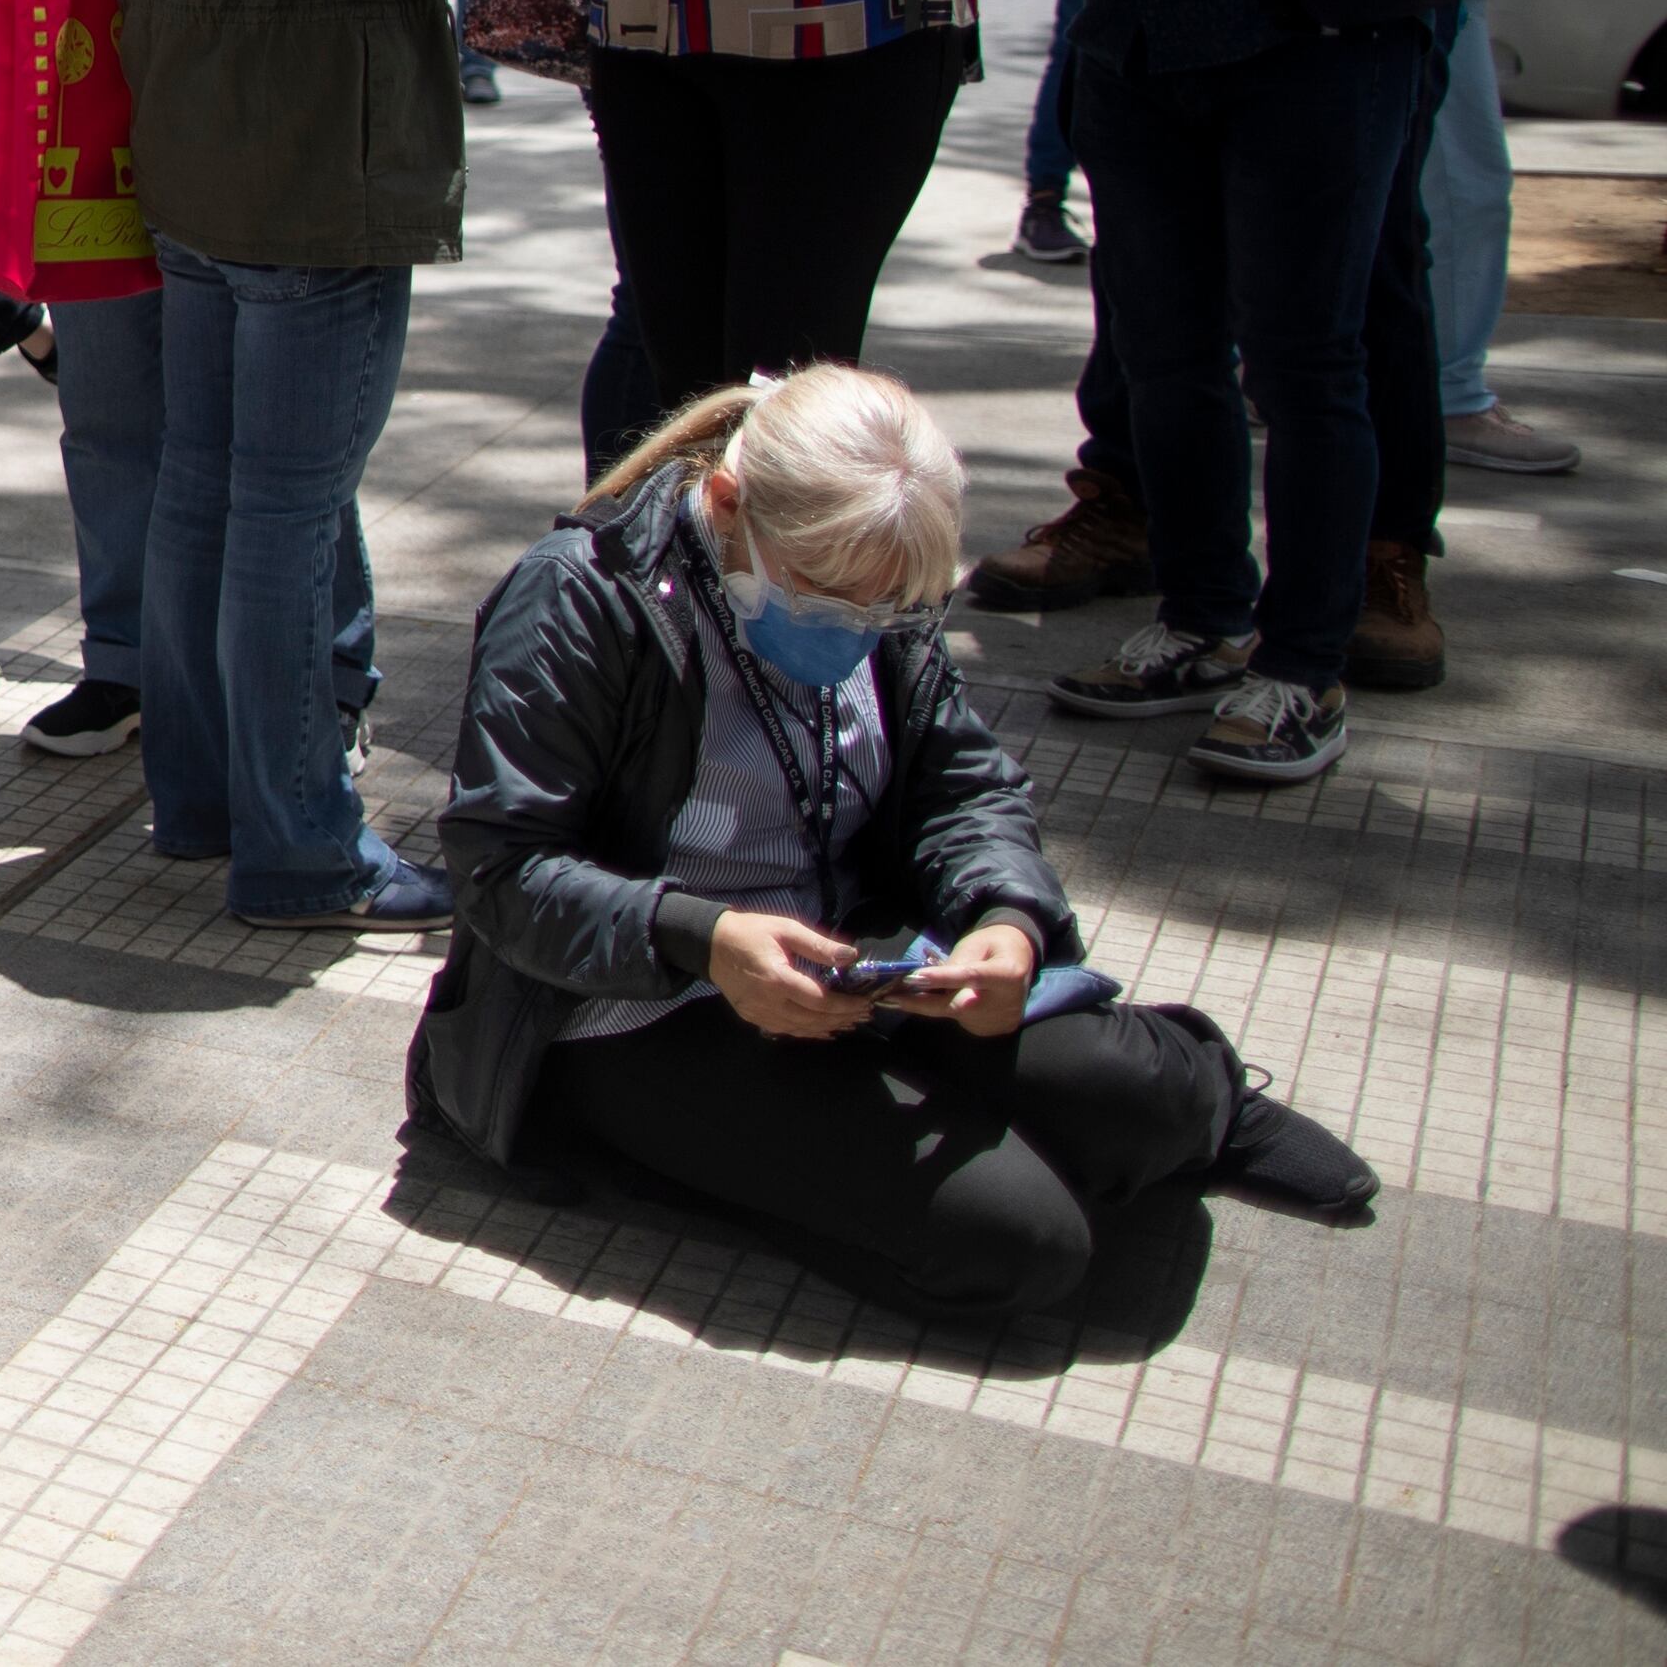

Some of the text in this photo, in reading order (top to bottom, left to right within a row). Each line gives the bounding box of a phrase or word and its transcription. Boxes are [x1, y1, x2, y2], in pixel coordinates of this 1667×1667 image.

[37, 206, 94, 248] La
[703, 577, 735, 634] HOSPITAL
[728, 635, 742, 653] DE
[737, 654, 767, 708] CLÍNICAS
